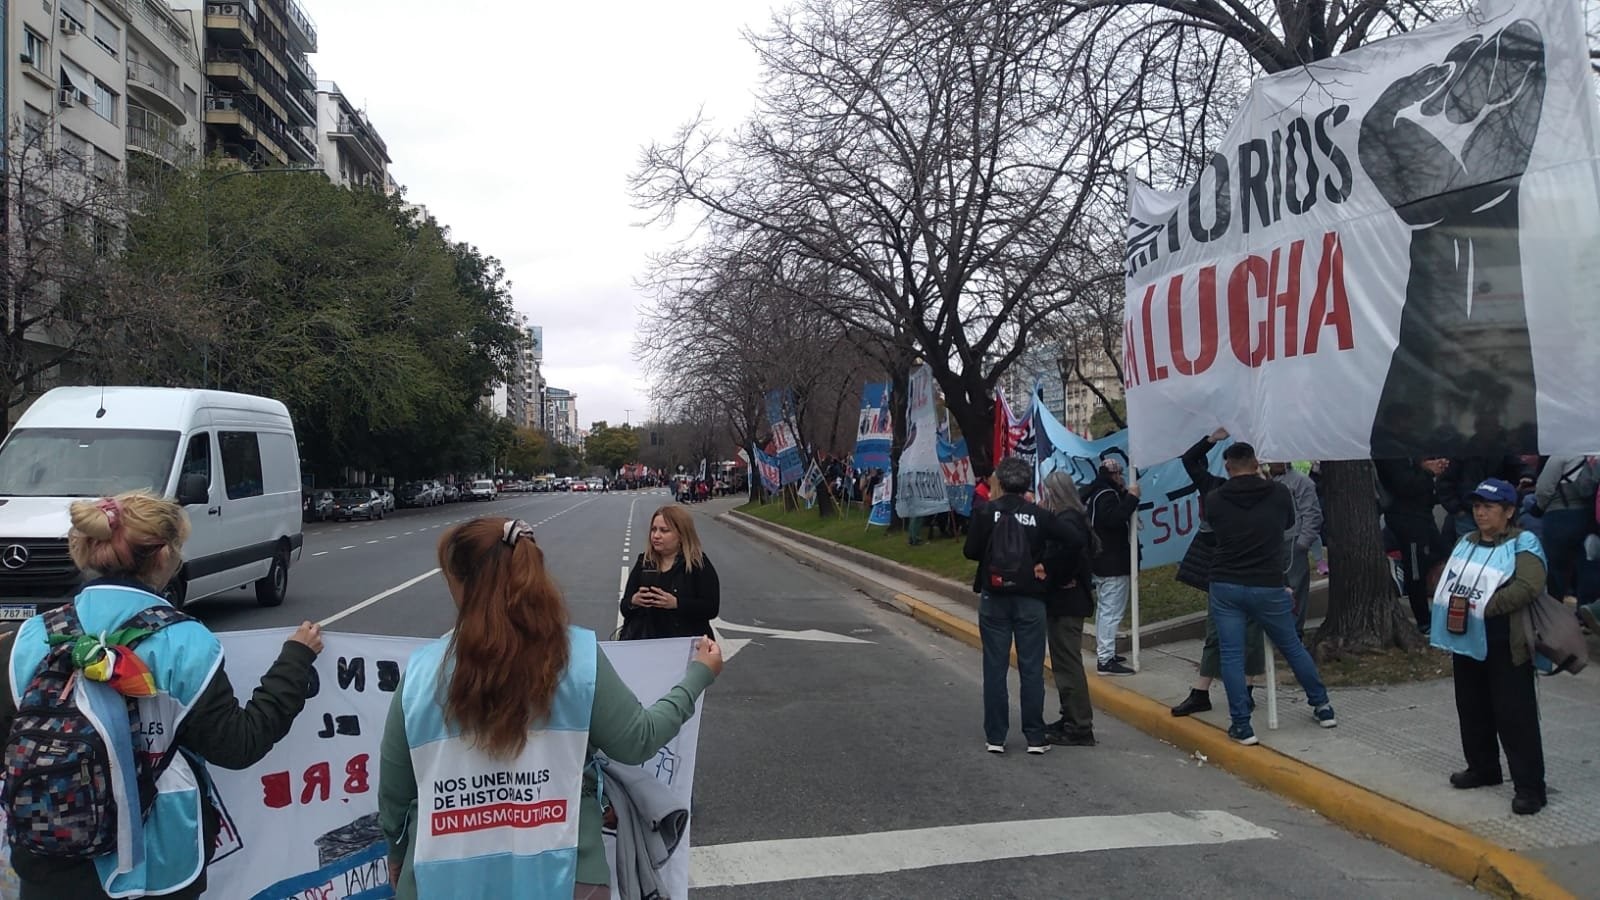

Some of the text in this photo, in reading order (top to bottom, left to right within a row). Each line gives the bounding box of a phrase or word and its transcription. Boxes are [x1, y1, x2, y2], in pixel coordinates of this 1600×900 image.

[1142, 231, 1354, 382] LUCHA
[994, 511, 1037, 527] PNSA
[1152, 496, 1204, 545] SU
[140, 722, 164, 735] LES
[434, 769, 550, 794] NOS UNEN MILES
[434, 795, 456, 811] DE
[460, 788, 534, 807] HISTORIAS
[434, 805, 564, 831] UN MISMO FUTURO
